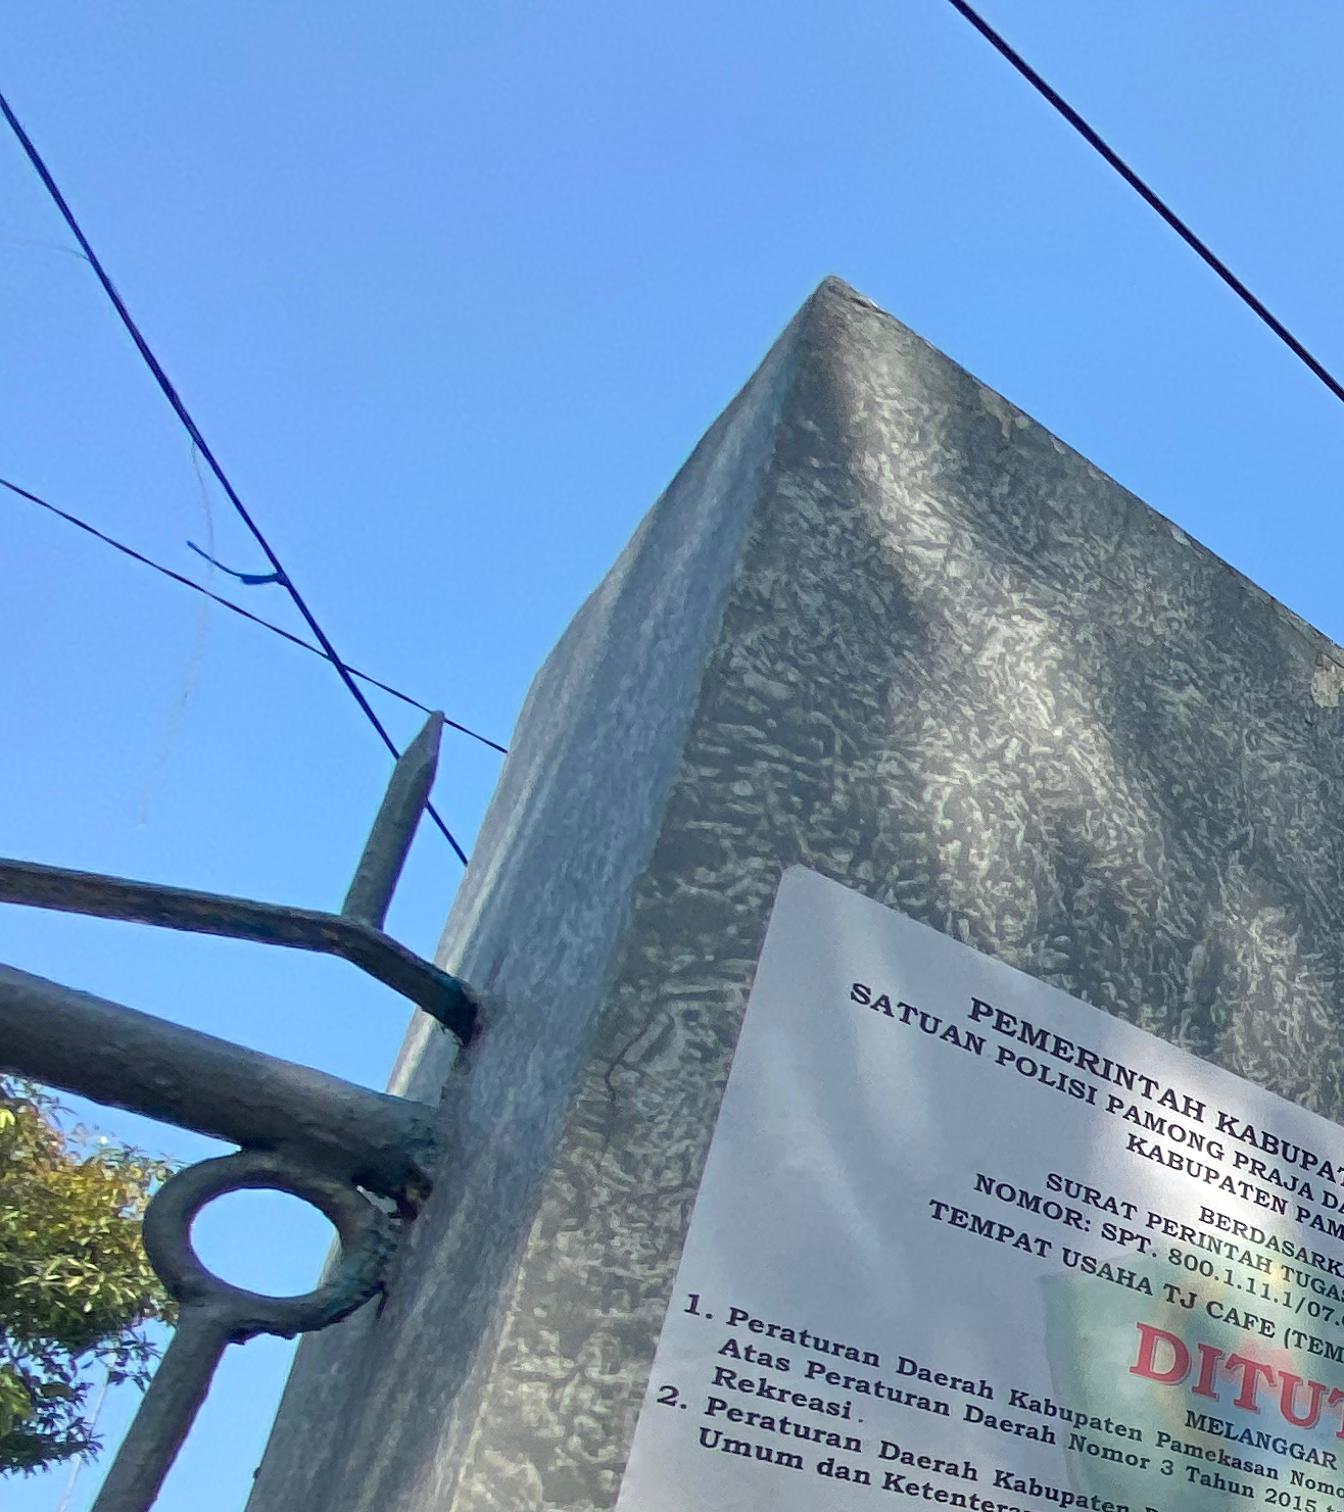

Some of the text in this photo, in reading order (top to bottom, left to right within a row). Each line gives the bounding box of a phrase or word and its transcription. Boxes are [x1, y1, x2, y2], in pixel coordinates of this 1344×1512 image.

[850, 982, 987, 1056] SATUAN
[994, 1045, 1098, 1106] POLISI
[1105, 1093, 1225, 1162] PAMONG
[1232, 1150, 1315, 1202] PRAJA
[967, 996, 1207, 1124] PEMERINTAH
[973, 1173, 1091, 1233] NOMOR:
[1100, 1222, 1157, 1258] SPT.
[1046, 1173, 1138, 1221] SURAT
[1144, 1211, 1273, 1275] PERINTAH
[1125, 1132, 1289, 1216] KABUPATEN
[928, 1199, 1053, 1258] TEMPAT
[1062, 1247, 1153, 1297] USAHA
[1162, 1282, 1198, 1310] TJ
[1205, 1300, 1276, 1339] CAFE
[656, 1385, 687, 1410] 2.
[703, 1396, 862, 1453] Peraturan
[877, 1440, 979, 1482] Daerah
[683, 1293, 713, 1320] 1.
[725, 1306, 881, 1368] Peraturan
[895, 1355, 994, 1401] Daerah
[1007, 1388, 1143, 1443] Kabupaten
[1155, 1430, 1279, 1481] Pamekasan
[717, 1338, 791, 1372] Atas
[804, 1360, 950, 1417] Peraturan
[962, 1403, 1056, 1445] Daerah
[1067, 1432, 1151, 1470] Nomor
[1160, 1459, 1174, 1476] 3
[1185, 1465, 1255, 1499] Tahun
[699, 1426, 804, 1471] Umum
[816, 1457, 872, 1486] dan
[1184, 1409, 1338, 1471] MELANGGAR
